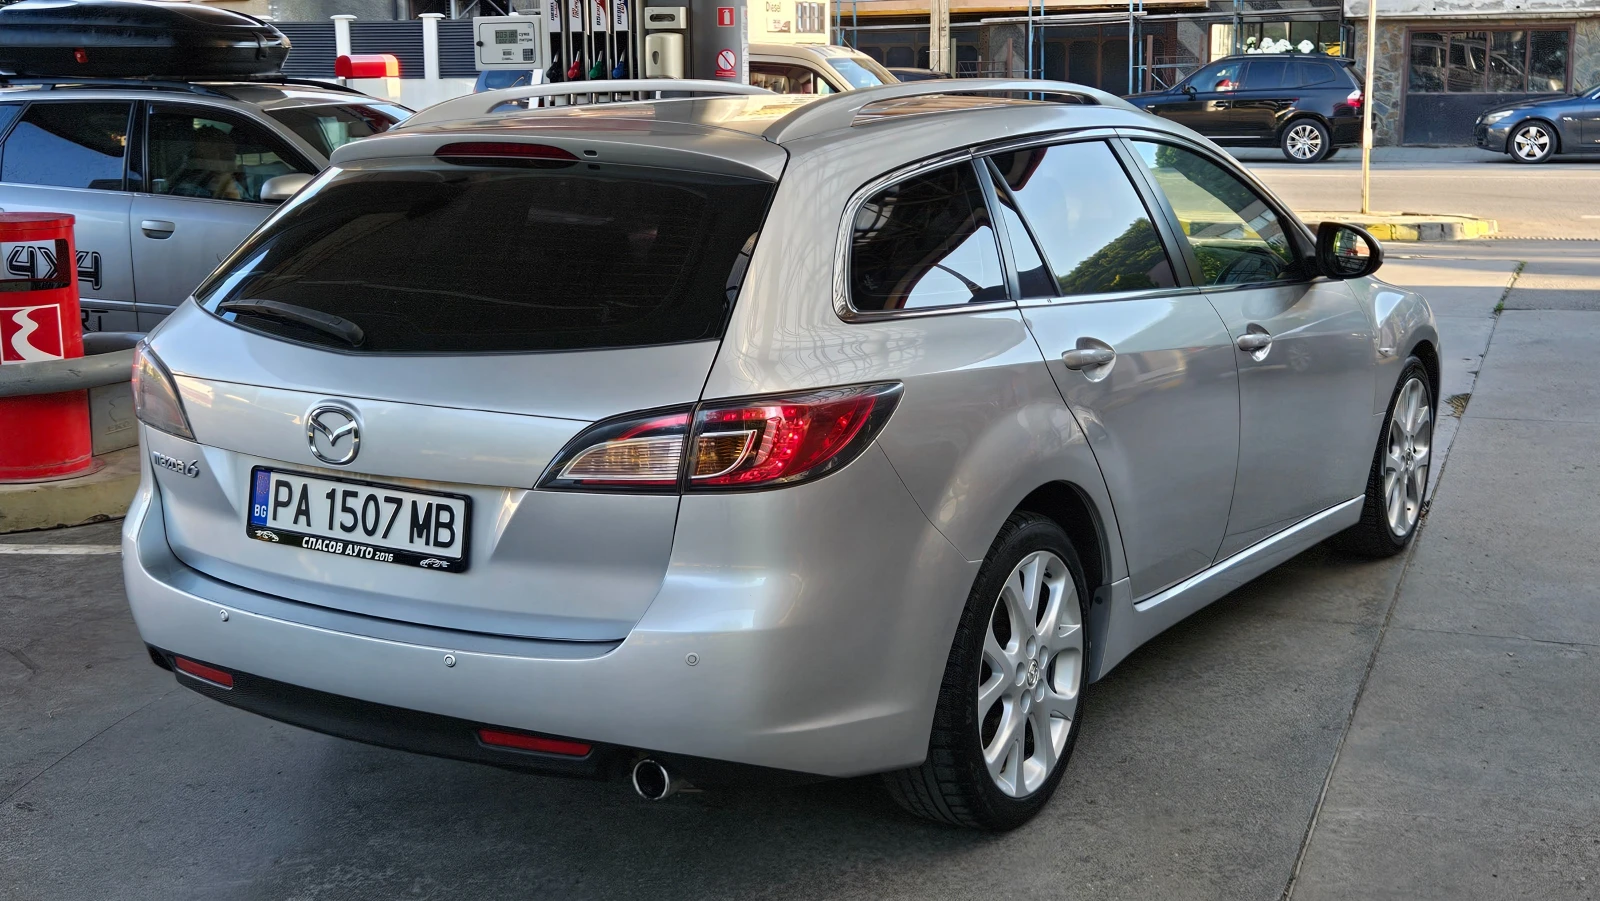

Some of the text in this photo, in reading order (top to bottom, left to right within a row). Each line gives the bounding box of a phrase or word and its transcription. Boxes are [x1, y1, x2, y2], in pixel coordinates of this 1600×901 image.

[254, 504, 267, 517] BG
[272, 479, 455, 548] PA 1507 MB
[302, 536, 393, 562] СПАСОВ АУТО 2016
